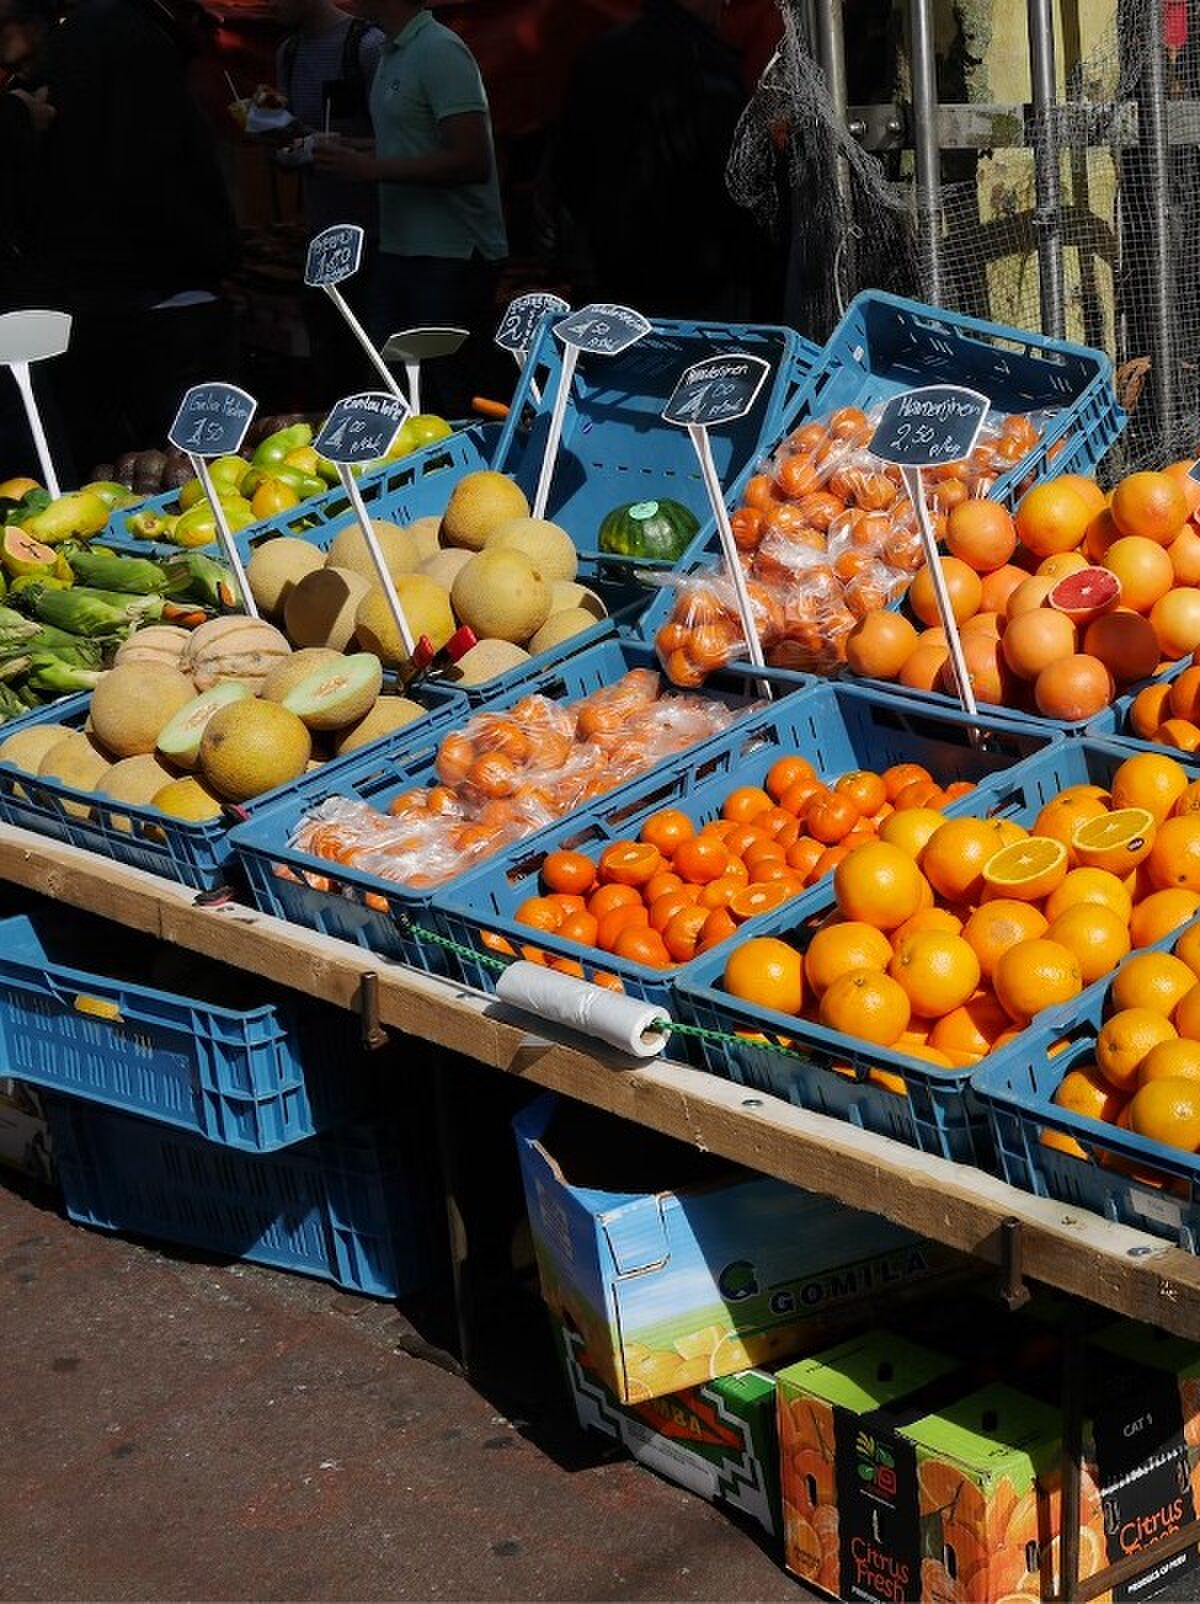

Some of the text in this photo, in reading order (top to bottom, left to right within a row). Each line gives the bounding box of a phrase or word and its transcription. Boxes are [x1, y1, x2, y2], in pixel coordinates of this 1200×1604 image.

[768, 1247, 931, 1315] GOMILA
[1123, 1415, 1146, 1438] CAT
[1119, 1496, 1186, 1553] Citrus
[850, 1536, 911, 1584] Citrus
